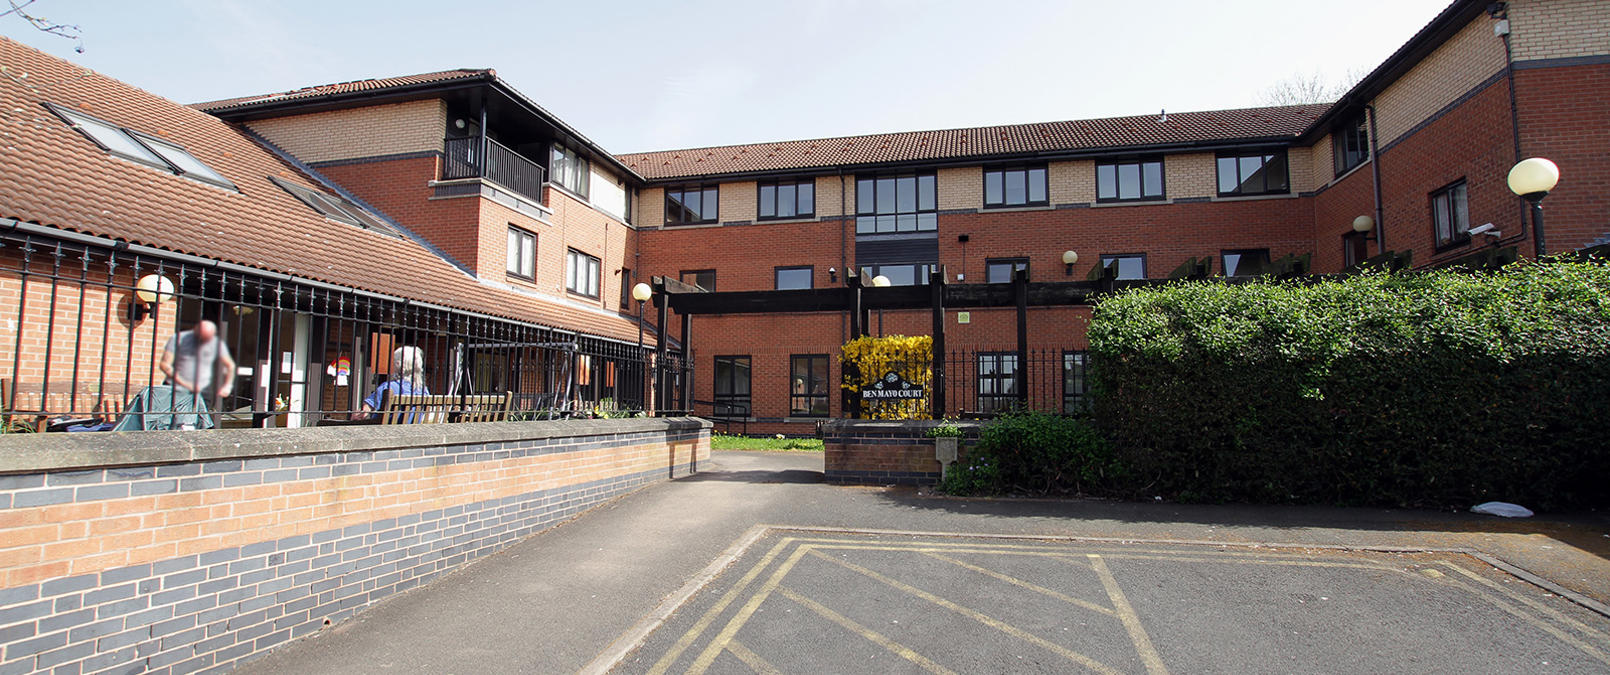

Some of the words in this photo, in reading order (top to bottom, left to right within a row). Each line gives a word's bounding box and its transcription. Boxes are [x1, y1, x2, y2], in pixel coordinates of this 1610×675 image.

[863, 390, 877, 398] BEN
[877, 390, 897, 398] MAYO
[898, 390, 922, 398] COURT
